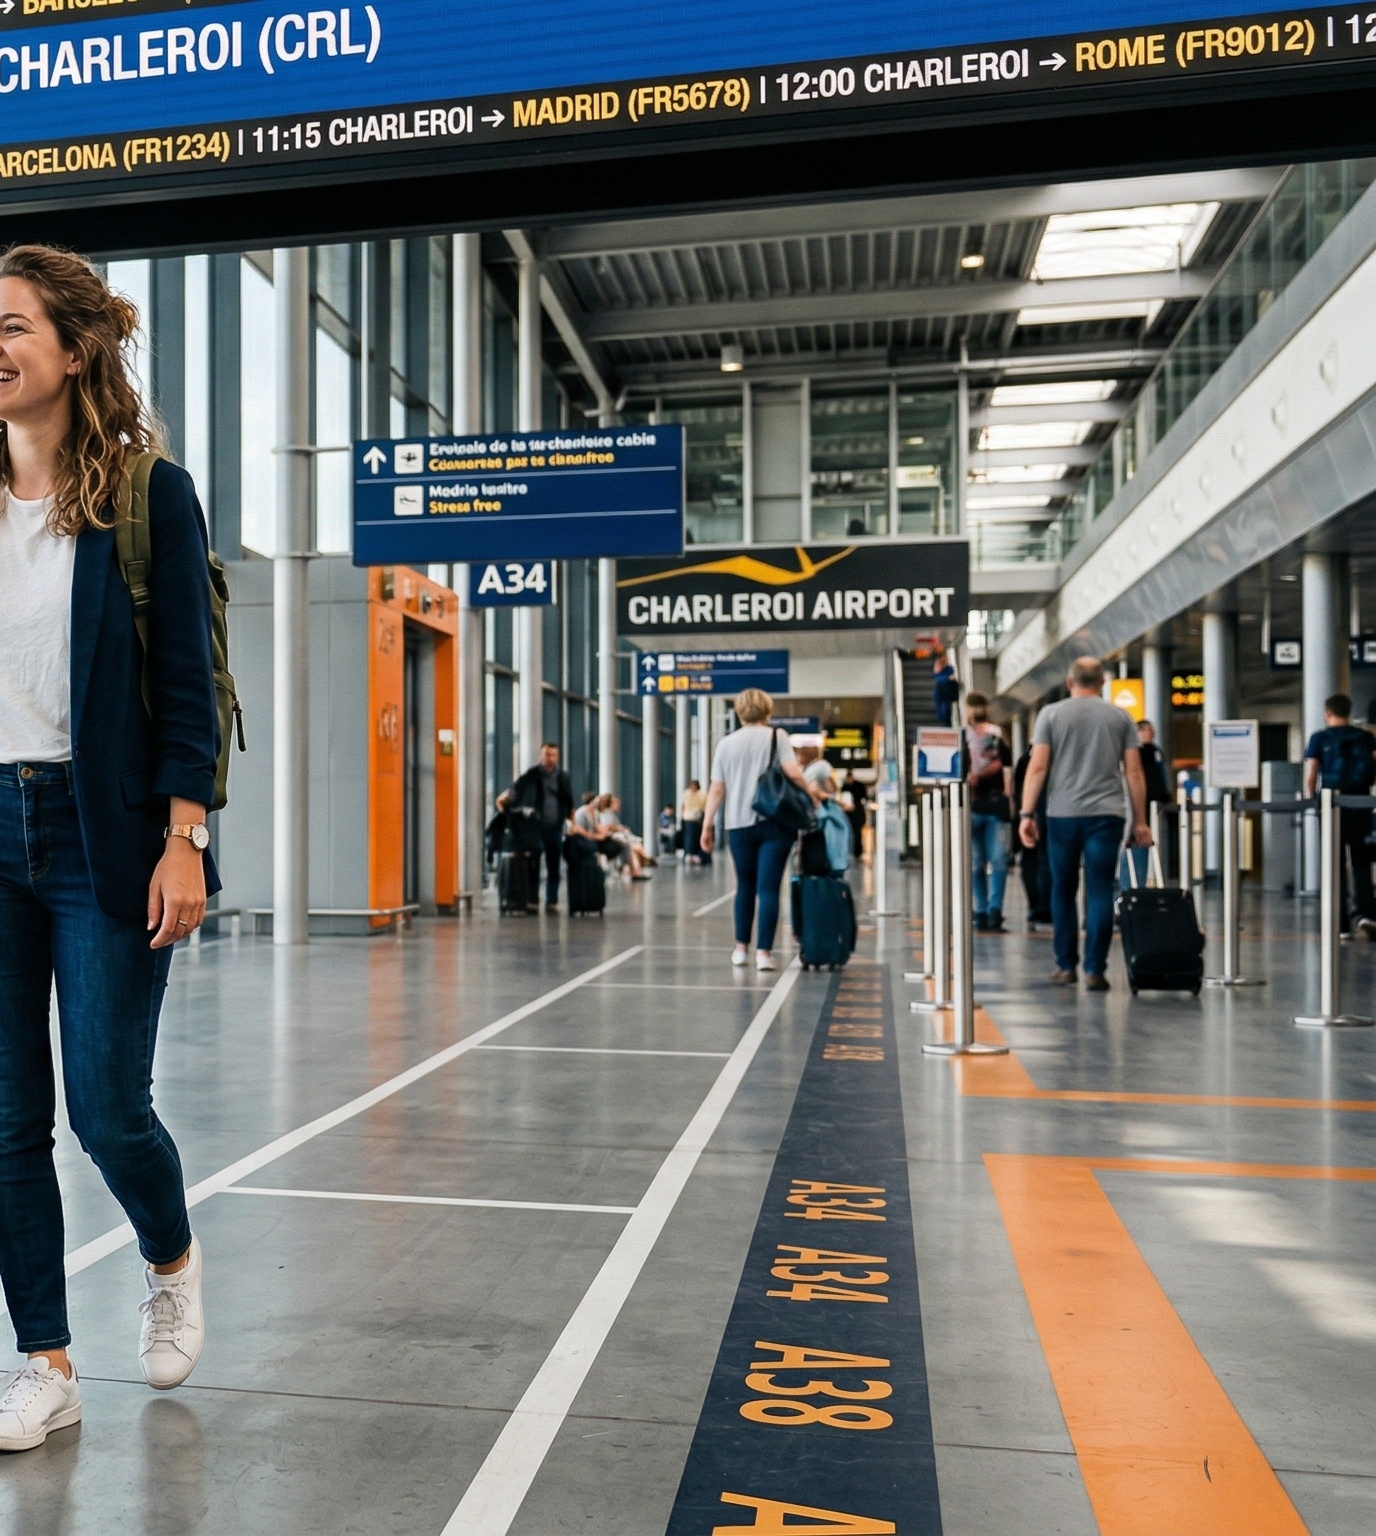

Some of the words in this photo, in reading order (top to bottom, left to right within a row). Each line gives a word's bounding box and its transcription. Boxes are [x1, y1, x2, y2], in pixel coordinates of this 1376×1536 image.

[258, 5, 381, 74] (CRL)
[123, 131, 230, 172] (FR1234)
[252, 122, 322, 153] 11:15
[328, 106, 474, 147] CHARLEROI
[512, 91, 620, 129] MADRID
[627, 76, 750, 121] (FR5678)
[774, 67, 855, 103] 12:00
[864, 49, 1030, 94] CHARLEROI
[1075, 35, 1165, 73] ROME
[1175, 18, 1316, 69] (FR9012)
[477, 563, 548, 595] A34
[628, 590, 805, 625] CHARLEROI
[812, 587, 955, 620] AIRPORT
[783, 1180, 886, 1221] A34
[767, 1245, 890, 1304] A34
[739, 1340, 894, 1430] A38
